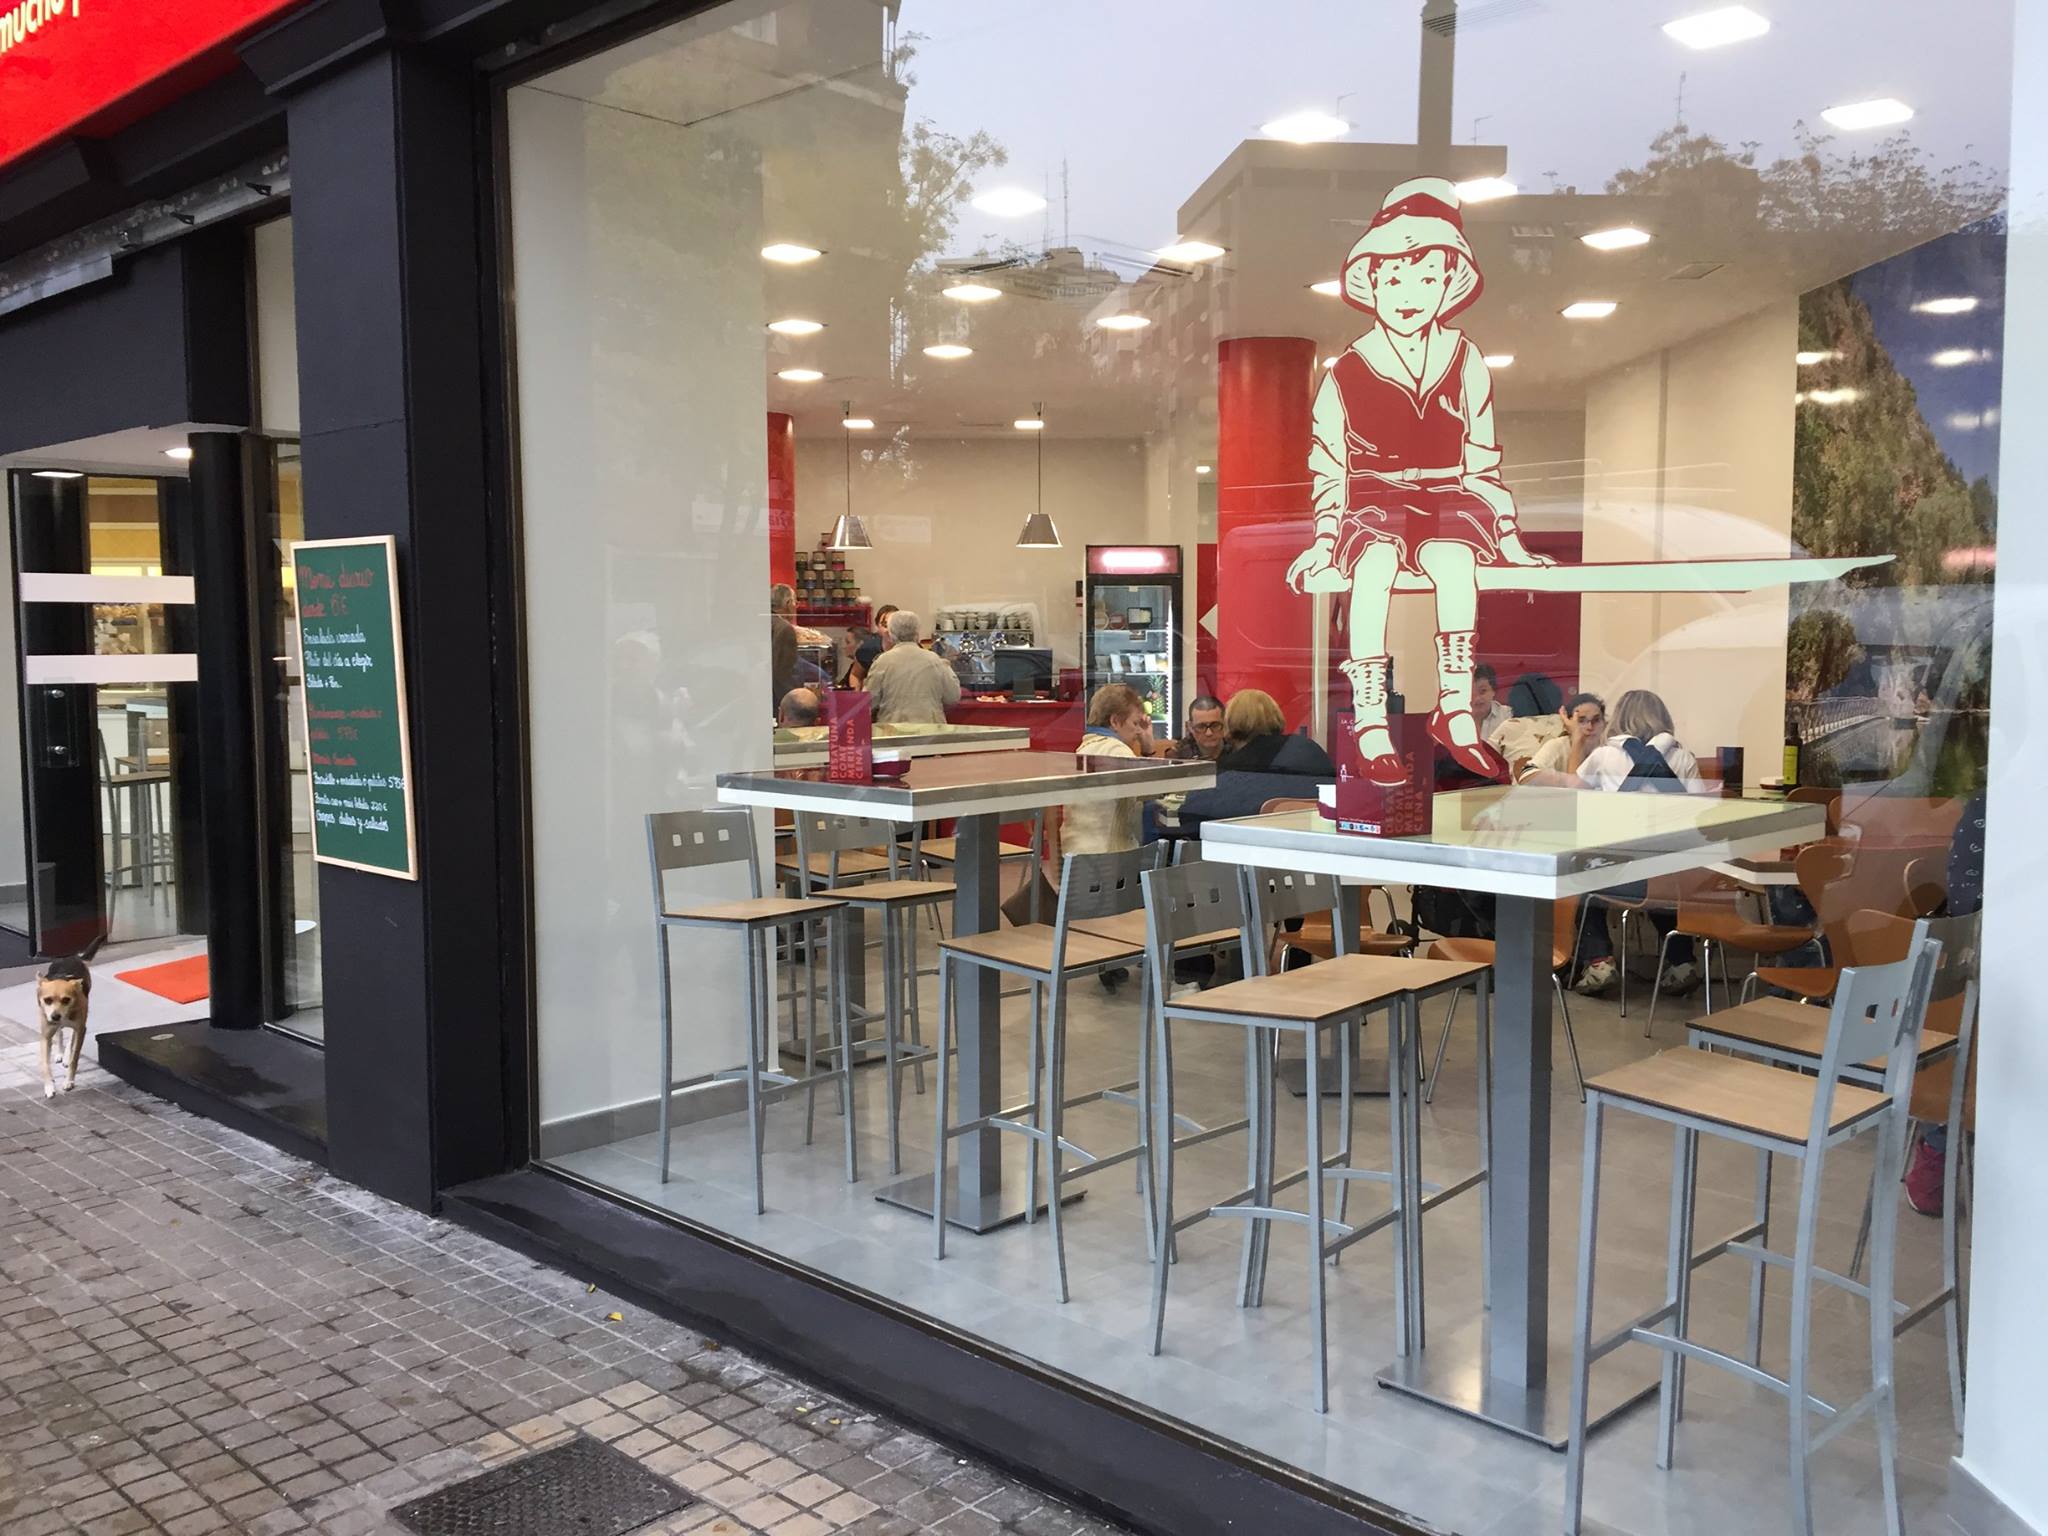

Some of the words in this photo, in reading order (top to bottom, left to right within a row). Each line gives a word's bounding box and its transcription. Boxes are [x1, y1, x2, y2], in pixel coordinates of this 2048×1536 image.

[830, 717, 839, 778] DESAYUNA
[839, 745, 847, 778] COME
[847, 719, 855, 779] MERIENDA
[855, 748, 864, 779] CENA
